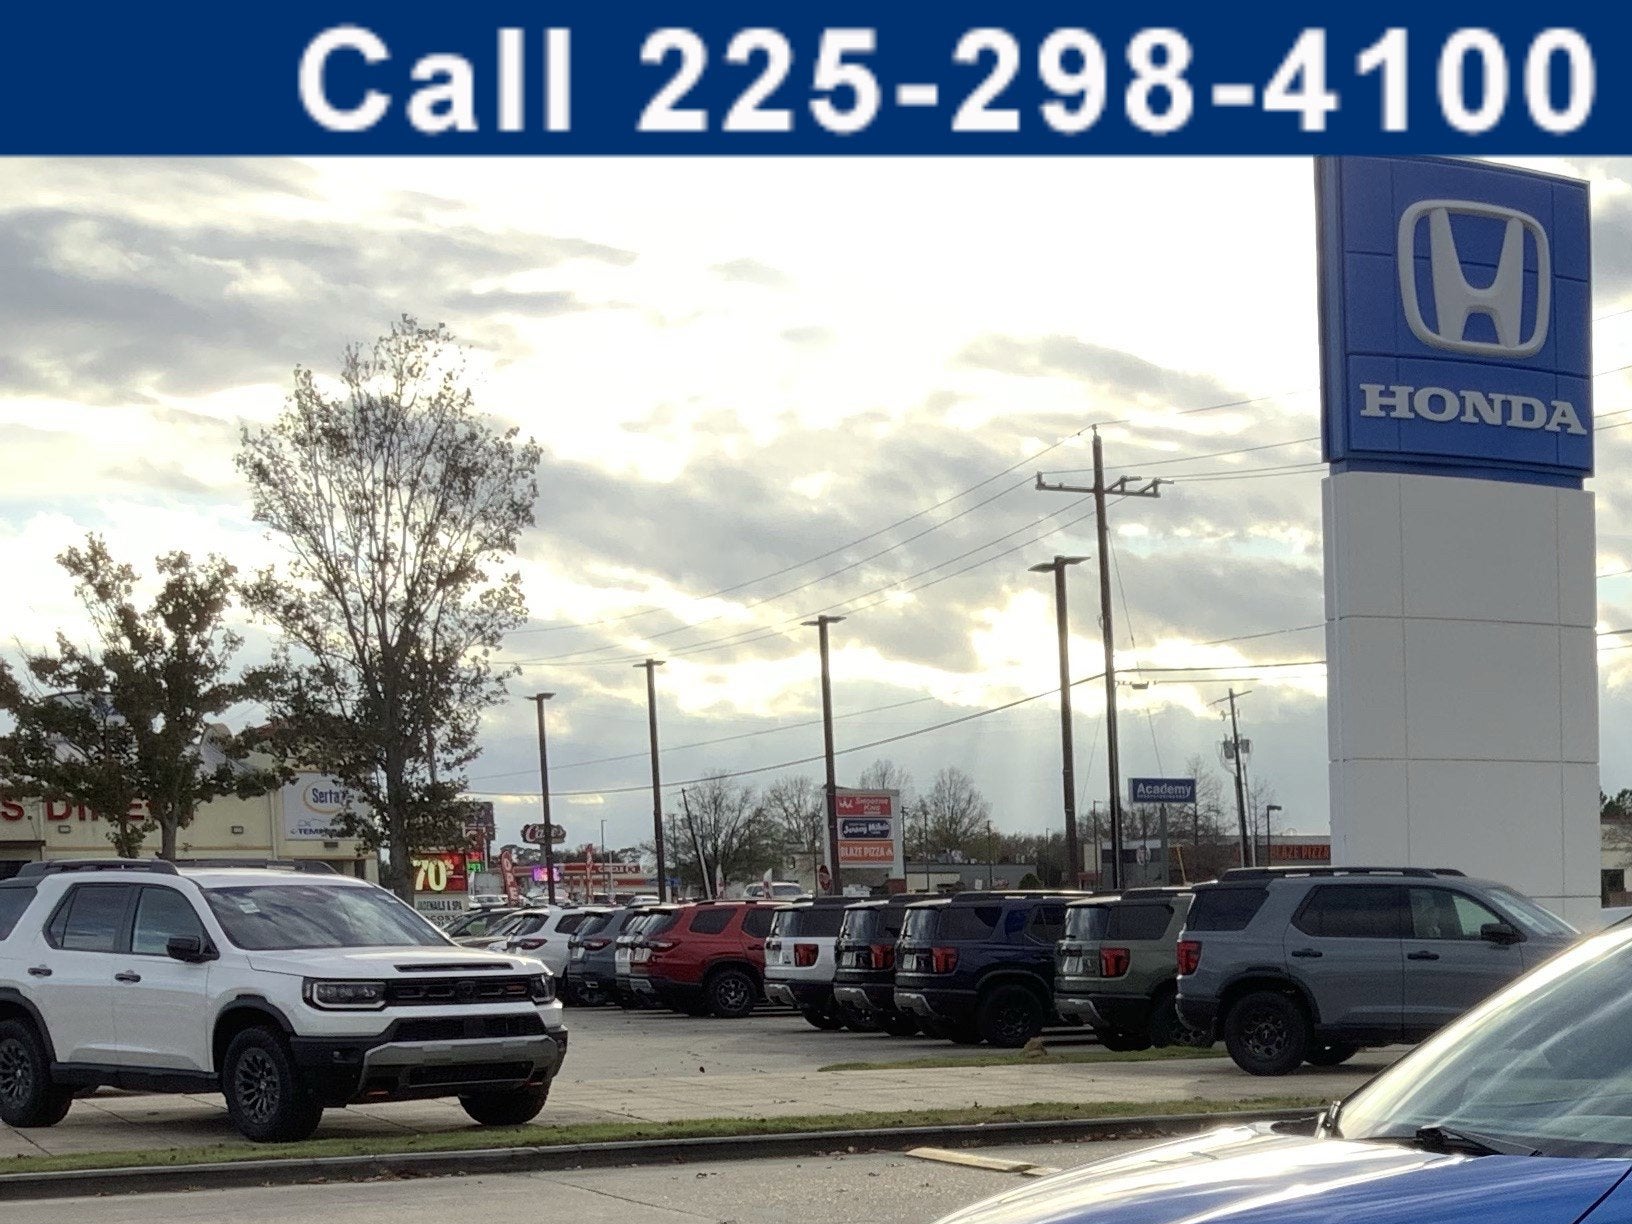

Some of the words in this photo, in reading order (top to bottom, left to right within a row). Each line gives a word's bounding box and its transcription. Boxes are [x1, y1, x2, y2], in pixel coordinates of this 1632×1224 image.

[1360, 383, 1588, 436] HONDA
[312, 787, 341, 804] Serta
[1136, 782, 1192, 799] Academy
[863, 846, 886, 857] PIZZA
